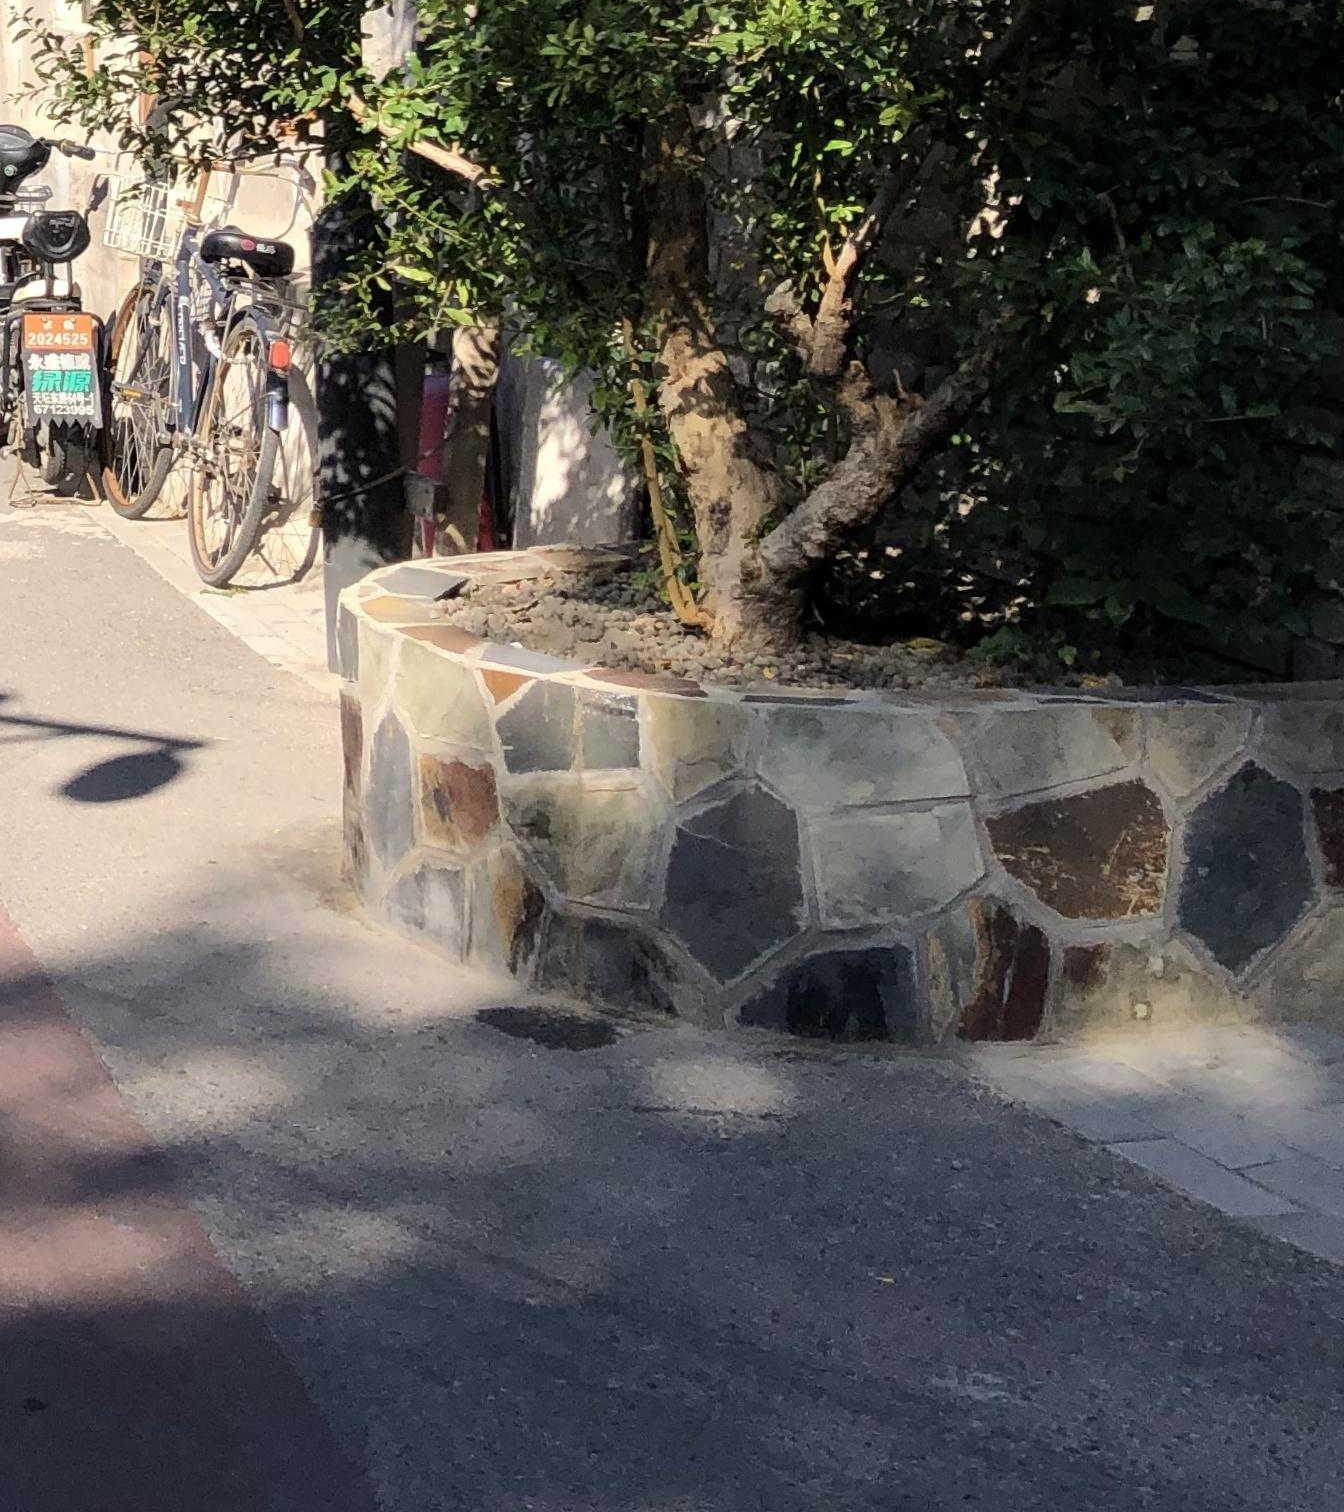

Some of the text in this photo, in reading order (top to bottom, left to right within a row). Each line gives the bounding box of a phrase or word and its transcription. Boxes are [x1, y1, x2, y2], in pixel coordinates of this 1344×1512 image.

[27, 332, 89, 347] 2024525
[32, 370, 91, 393] 绿源
[32, 405, 95, 416] 67123995
